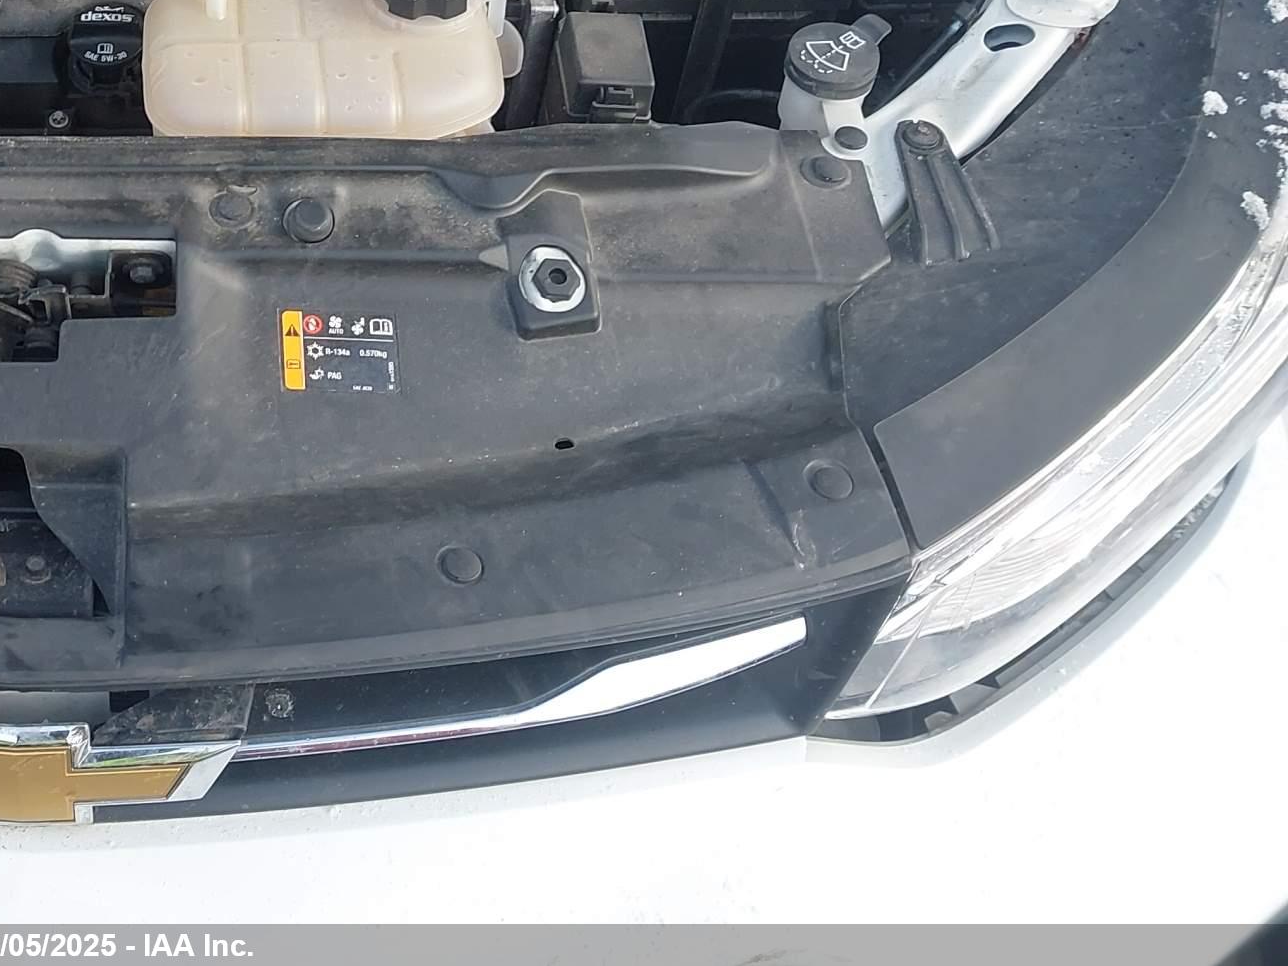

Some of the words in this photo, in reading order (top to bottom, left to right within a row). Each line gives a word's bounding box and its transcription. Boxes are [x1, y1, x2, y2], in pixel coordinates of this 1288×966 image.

[80, 10, 136, 23] dexos
[83, 50, 100, 62] SAE
[100, 50, 128, 63] 5W-30
[325, 347, 351, 356] R-134a
[327, 371, 342, 380] PAG
